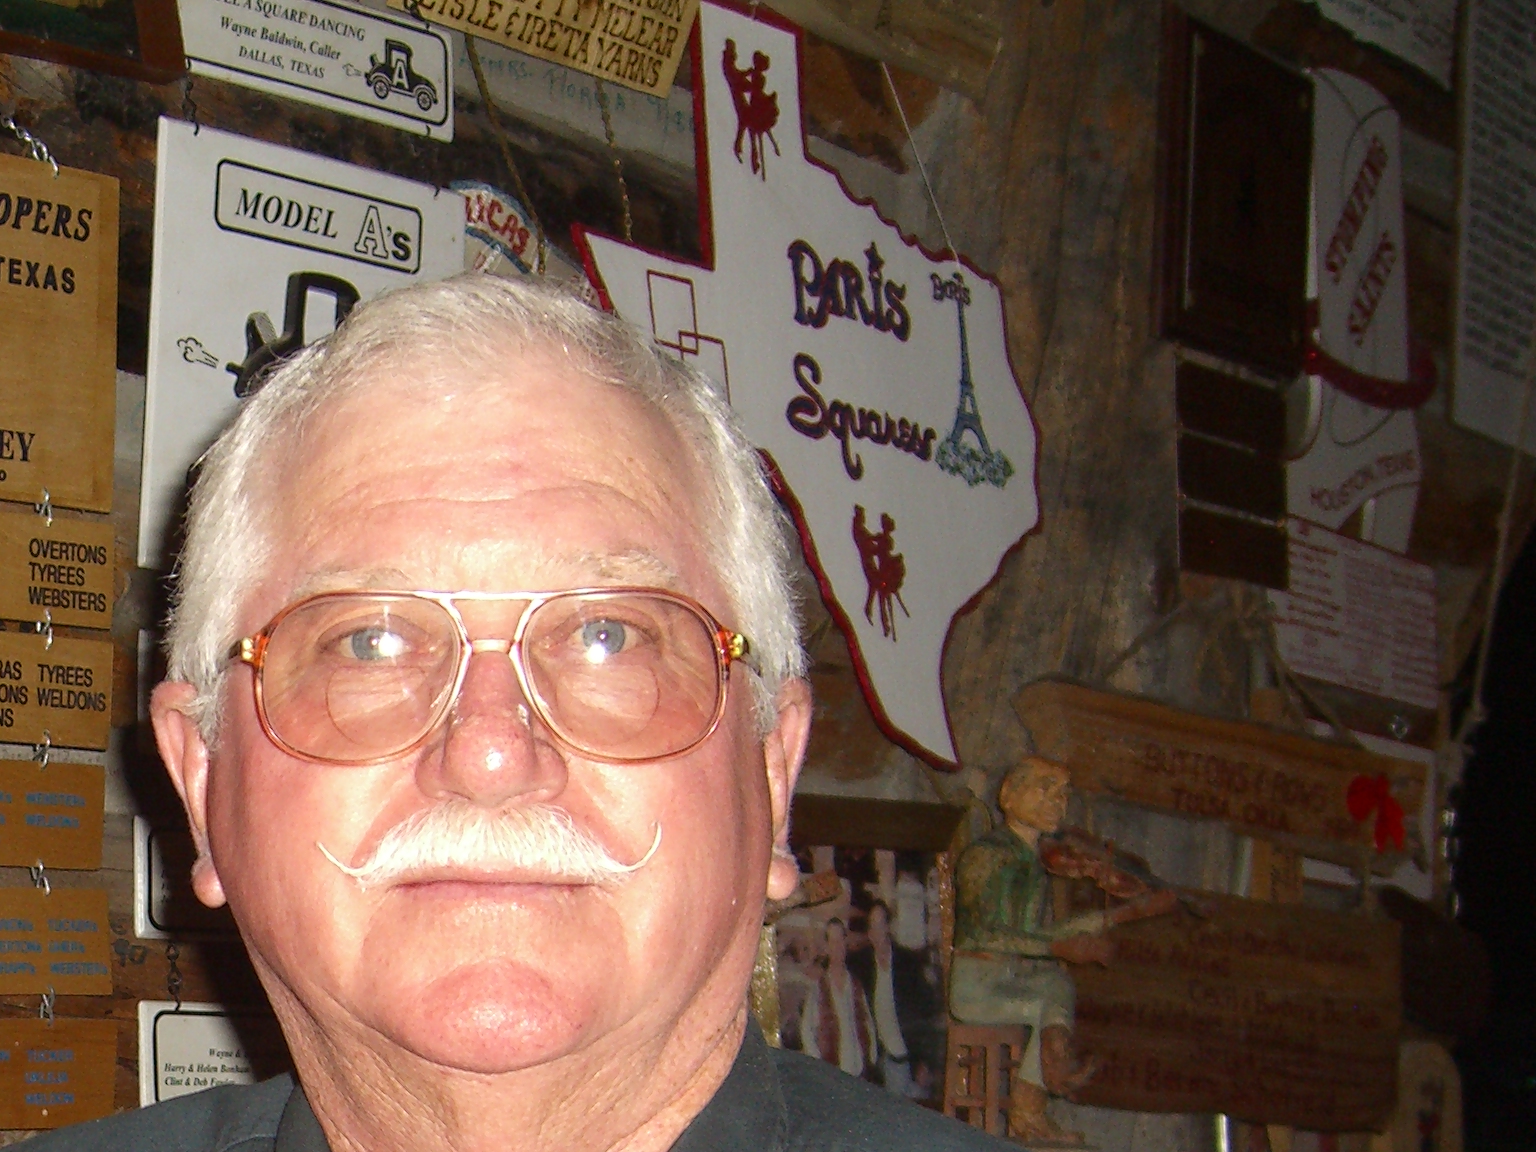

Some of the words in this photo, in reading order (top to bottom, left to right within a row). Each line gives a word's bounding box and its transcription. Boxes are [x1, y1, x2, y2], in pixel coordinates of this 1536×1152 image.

[254, 0, 305, 24] SQUARE
[310, 15, 365, 41] DANCING
[221, 16, 257, 38] Wayne
[310, 41, 341, 60] Caller
[239, 46, 284, 68] DALLAS,
[291, 59, 325, 78] TEXAS
[597, 37, 663, 88] YARNS
[235, 188, 338, 238] MODEL
[355, 205, 411, 261] A's
[466, 194, 530, 256] UCAS
[28, 538, 106, 565] OVERTONS
[29, 562, 85, 586] TYREES
[28, 587, 106, 613] WEBSTERS
[37, 663, 93, 687] TYREES
[37, 687, 106, 712] WELDONS
[165, 1064, 185, 1074] Harry
[188, 1064, 193, 1072] &
